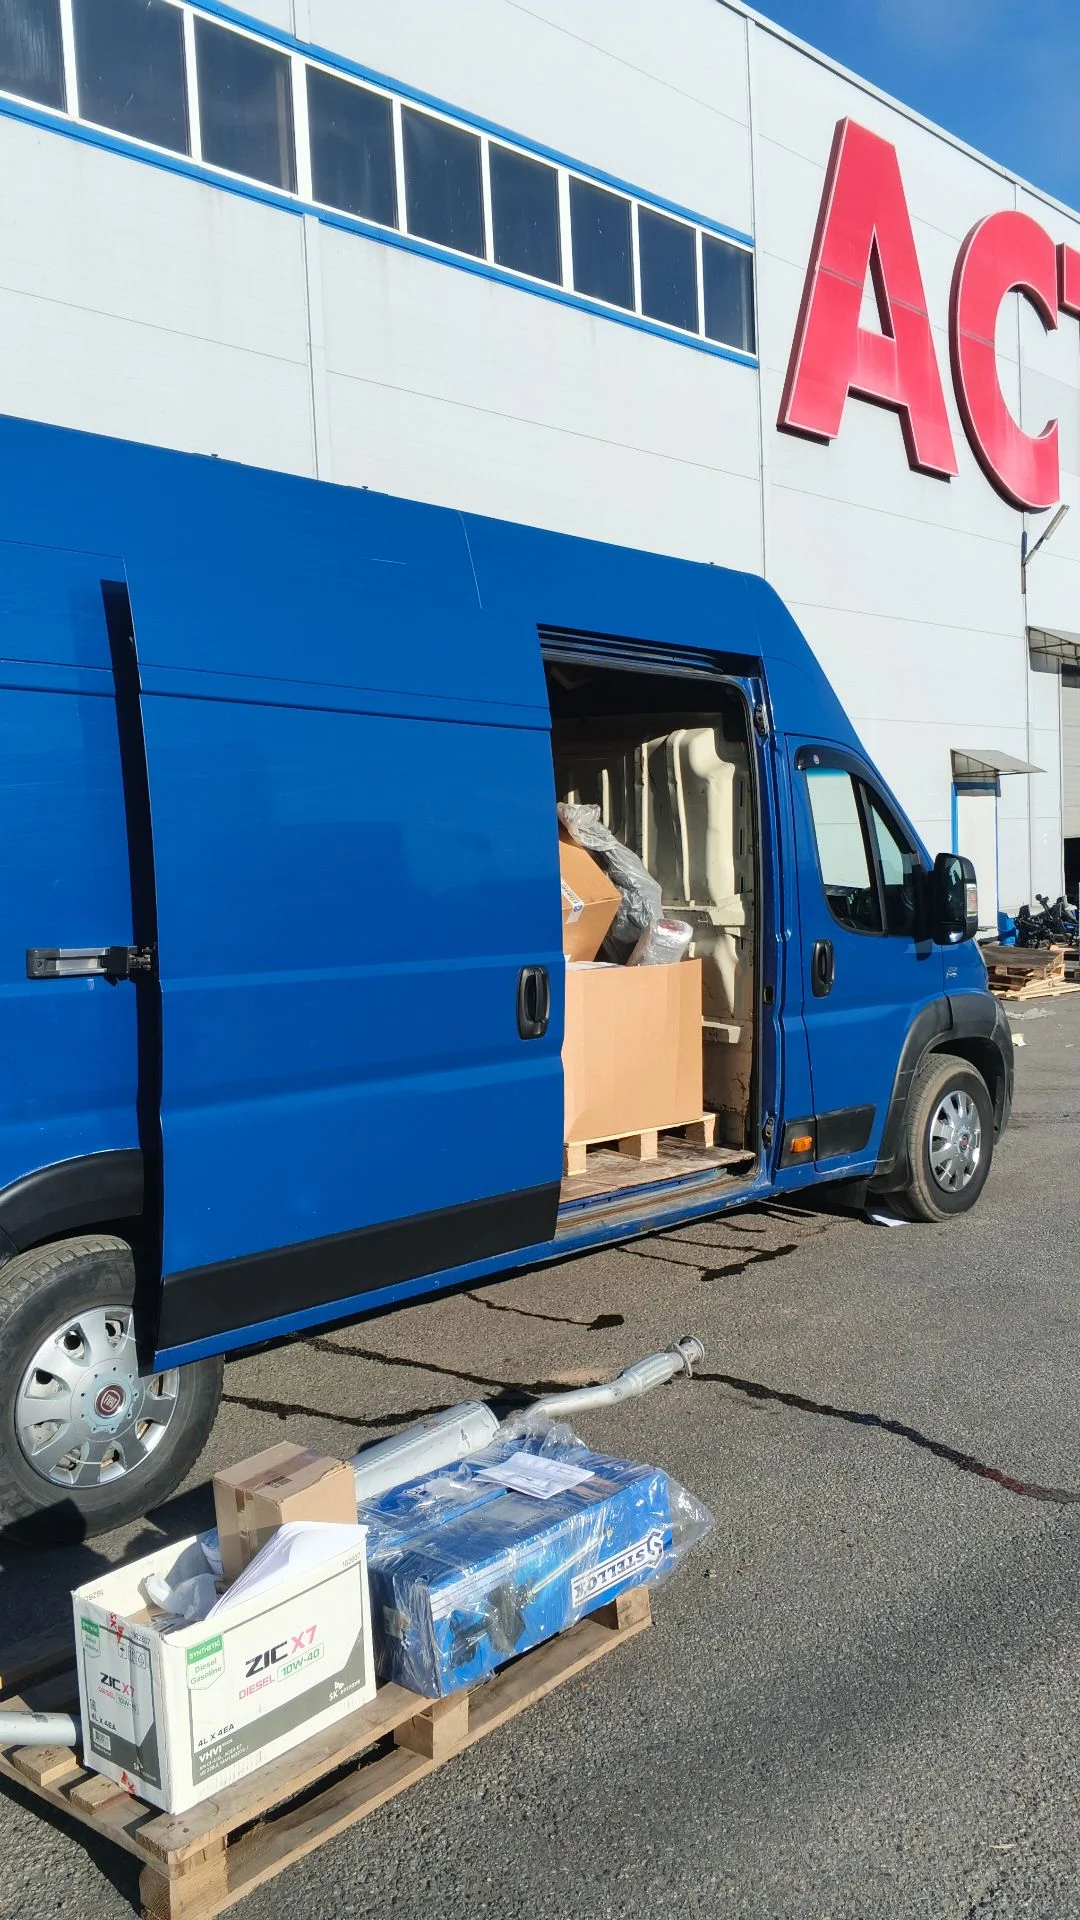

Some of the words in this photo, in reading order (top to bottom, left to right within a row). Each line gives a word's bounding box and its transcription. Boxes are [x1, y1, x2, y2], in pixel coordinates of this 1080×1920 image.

[777, 116, 1080, 514] AC
[188, 1640, 221, 1660] SYNTHETIC
[245, 1640, 288, 1678] ZIC
[290, 1624, 317, 1655] X7
[190, 1666, 222, 1685] Gasoline
[194, 1658, 217, 1674] Diesel
[238, 1674, 276, 1700] DIESEL
[281, 1648, 320, 1677] 10W-40
[100, 1671, 121, 1691] ZIC
[329, 1690, 339, 1701] SK
[198, 1738, 208, 1747] 4L
[217, 1723, 235, 1736] 4EA
[199, 1745, 222, 1763] VHVI
